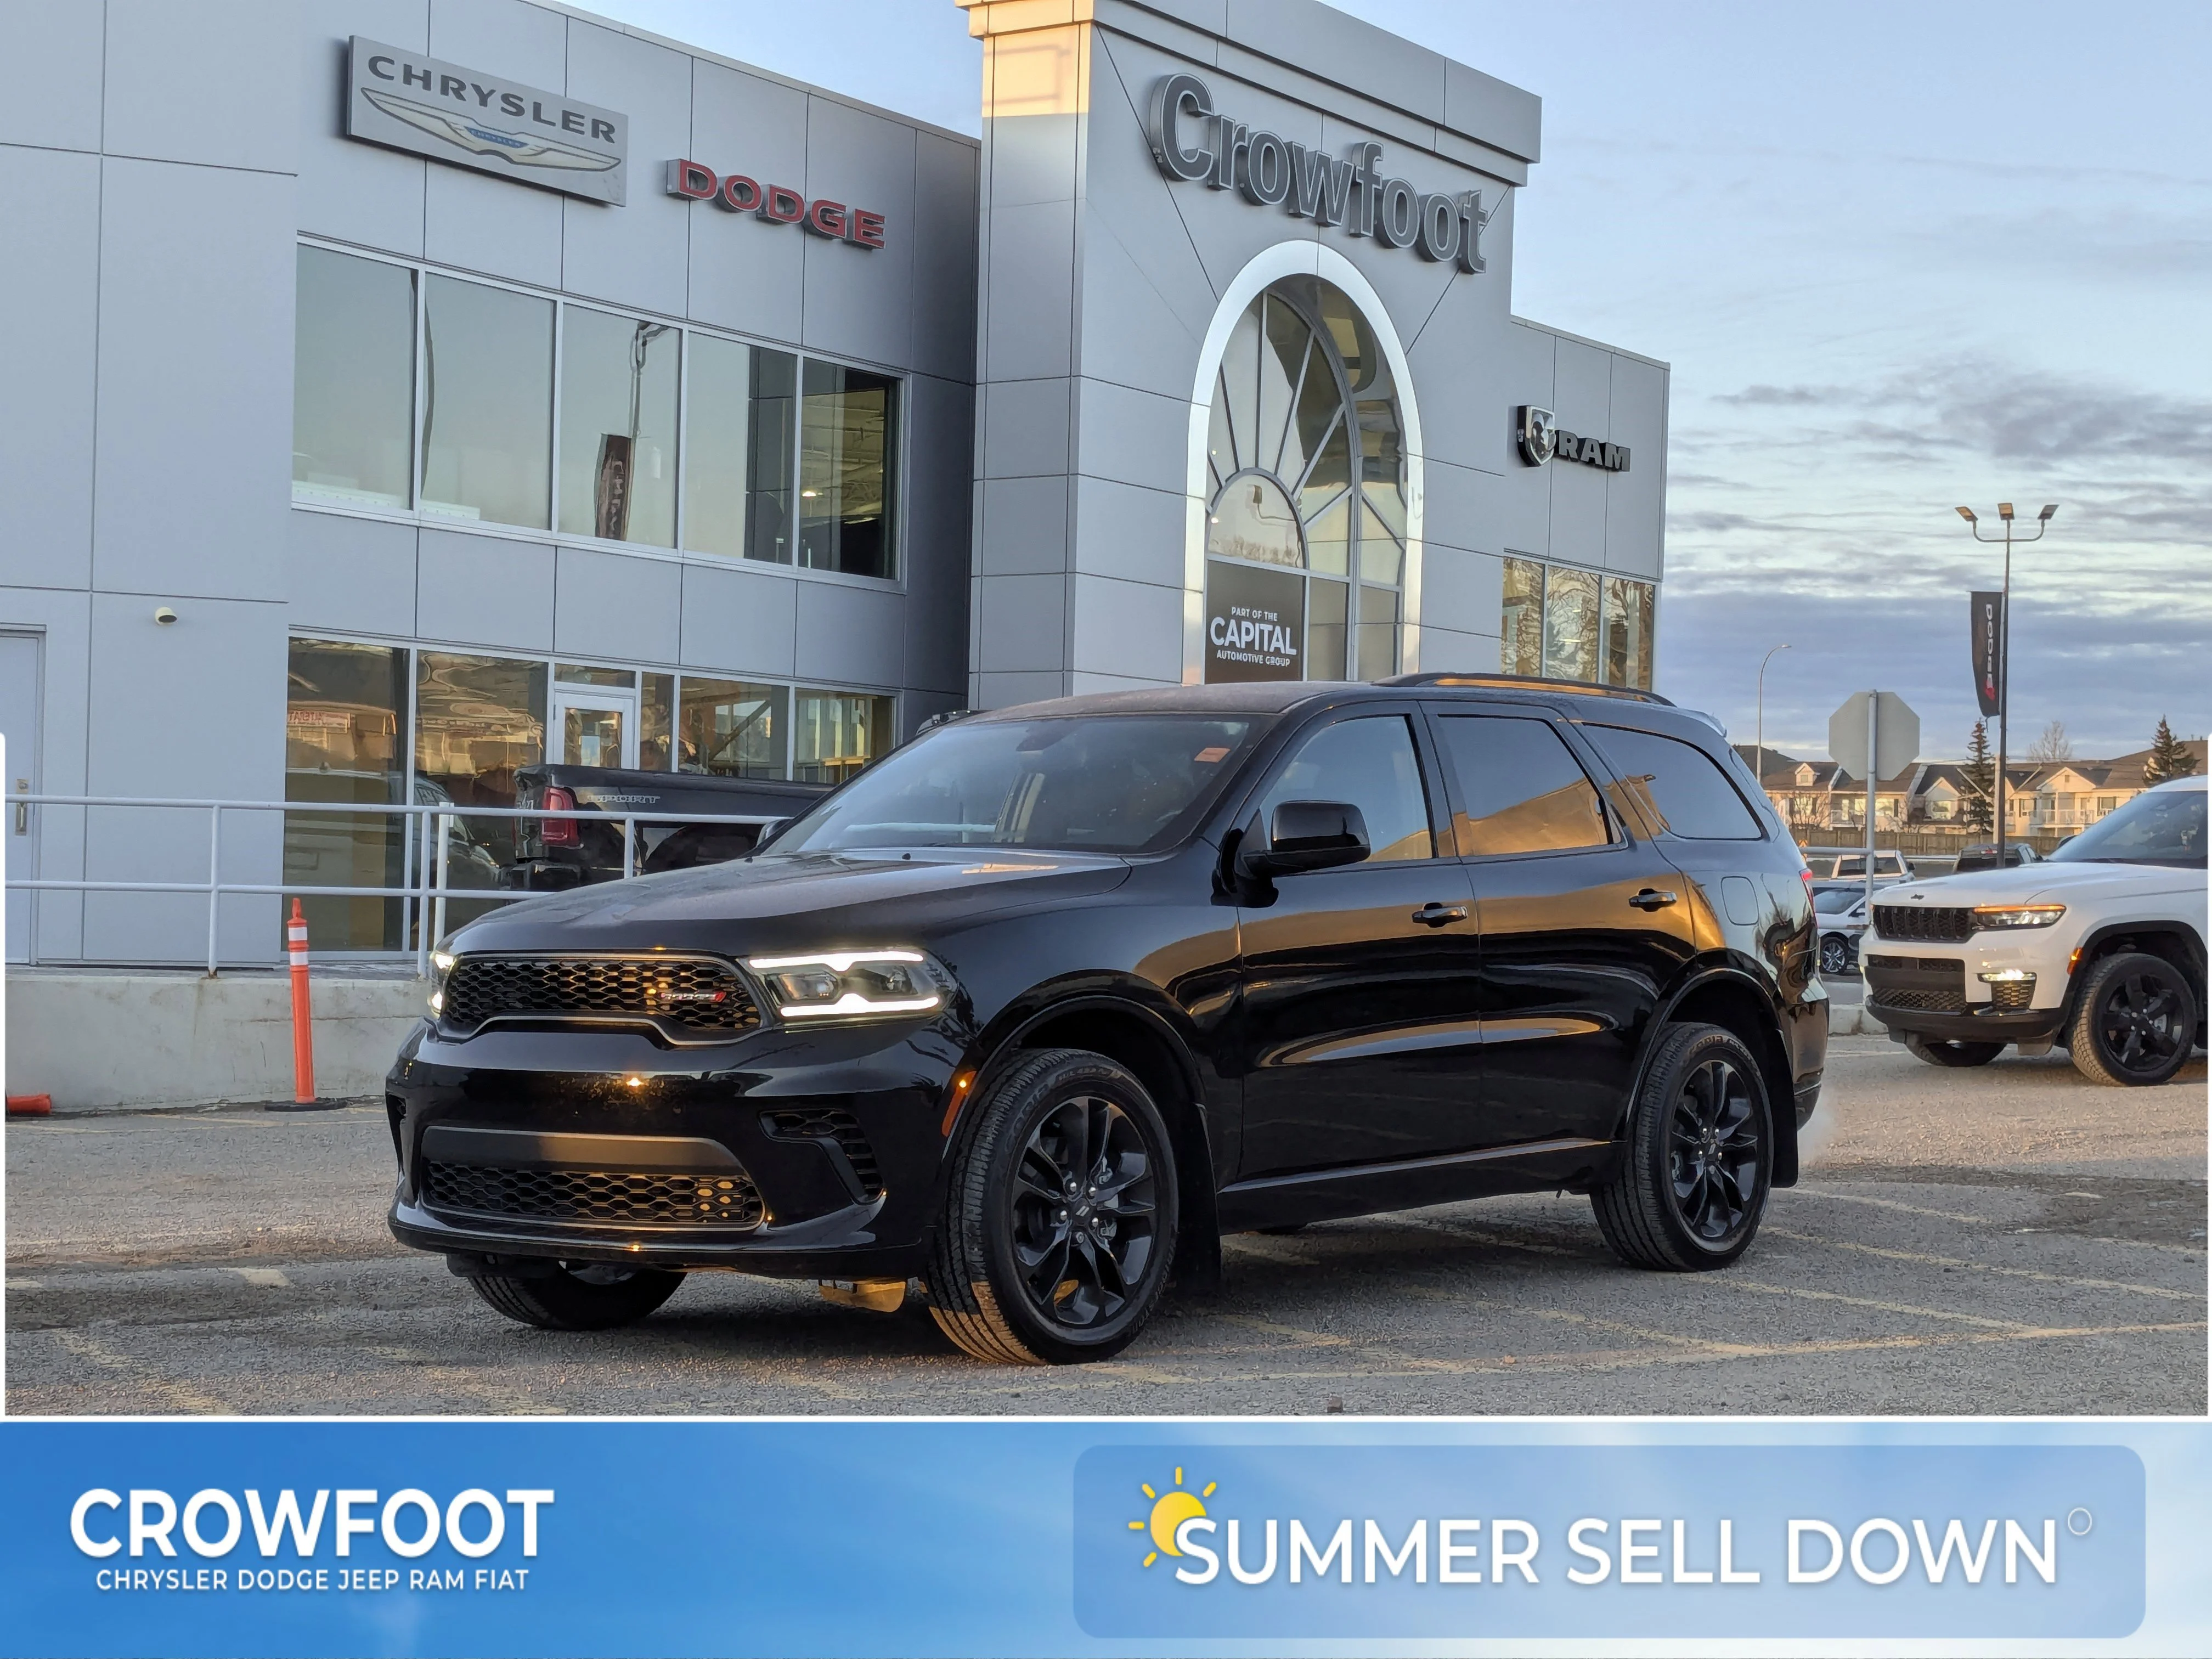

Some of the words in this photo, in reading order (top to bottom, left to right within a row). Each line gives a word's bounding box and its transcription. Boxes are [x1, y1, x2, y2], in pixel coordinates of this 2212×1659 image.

[368, 55, 617, 144] CHRYSLER
[1155, 72, 1488, 274] Crowfoot
[675, 159, 886, 249] DODGE
[1558, 430, 1631, 472] RAM
[1231, 606, 1250, 617] PART
[1252, 610, 1262, 619] OF
[1264, 611, 1278, 622] THE
[1210, 617, 1297, 656] CAPITAL
[1216, 649, 1263, 664] AUTOMOTIVE
[1265, 656, 1290, 667] GROUP
[586, 794, 661, 804] SPORT
